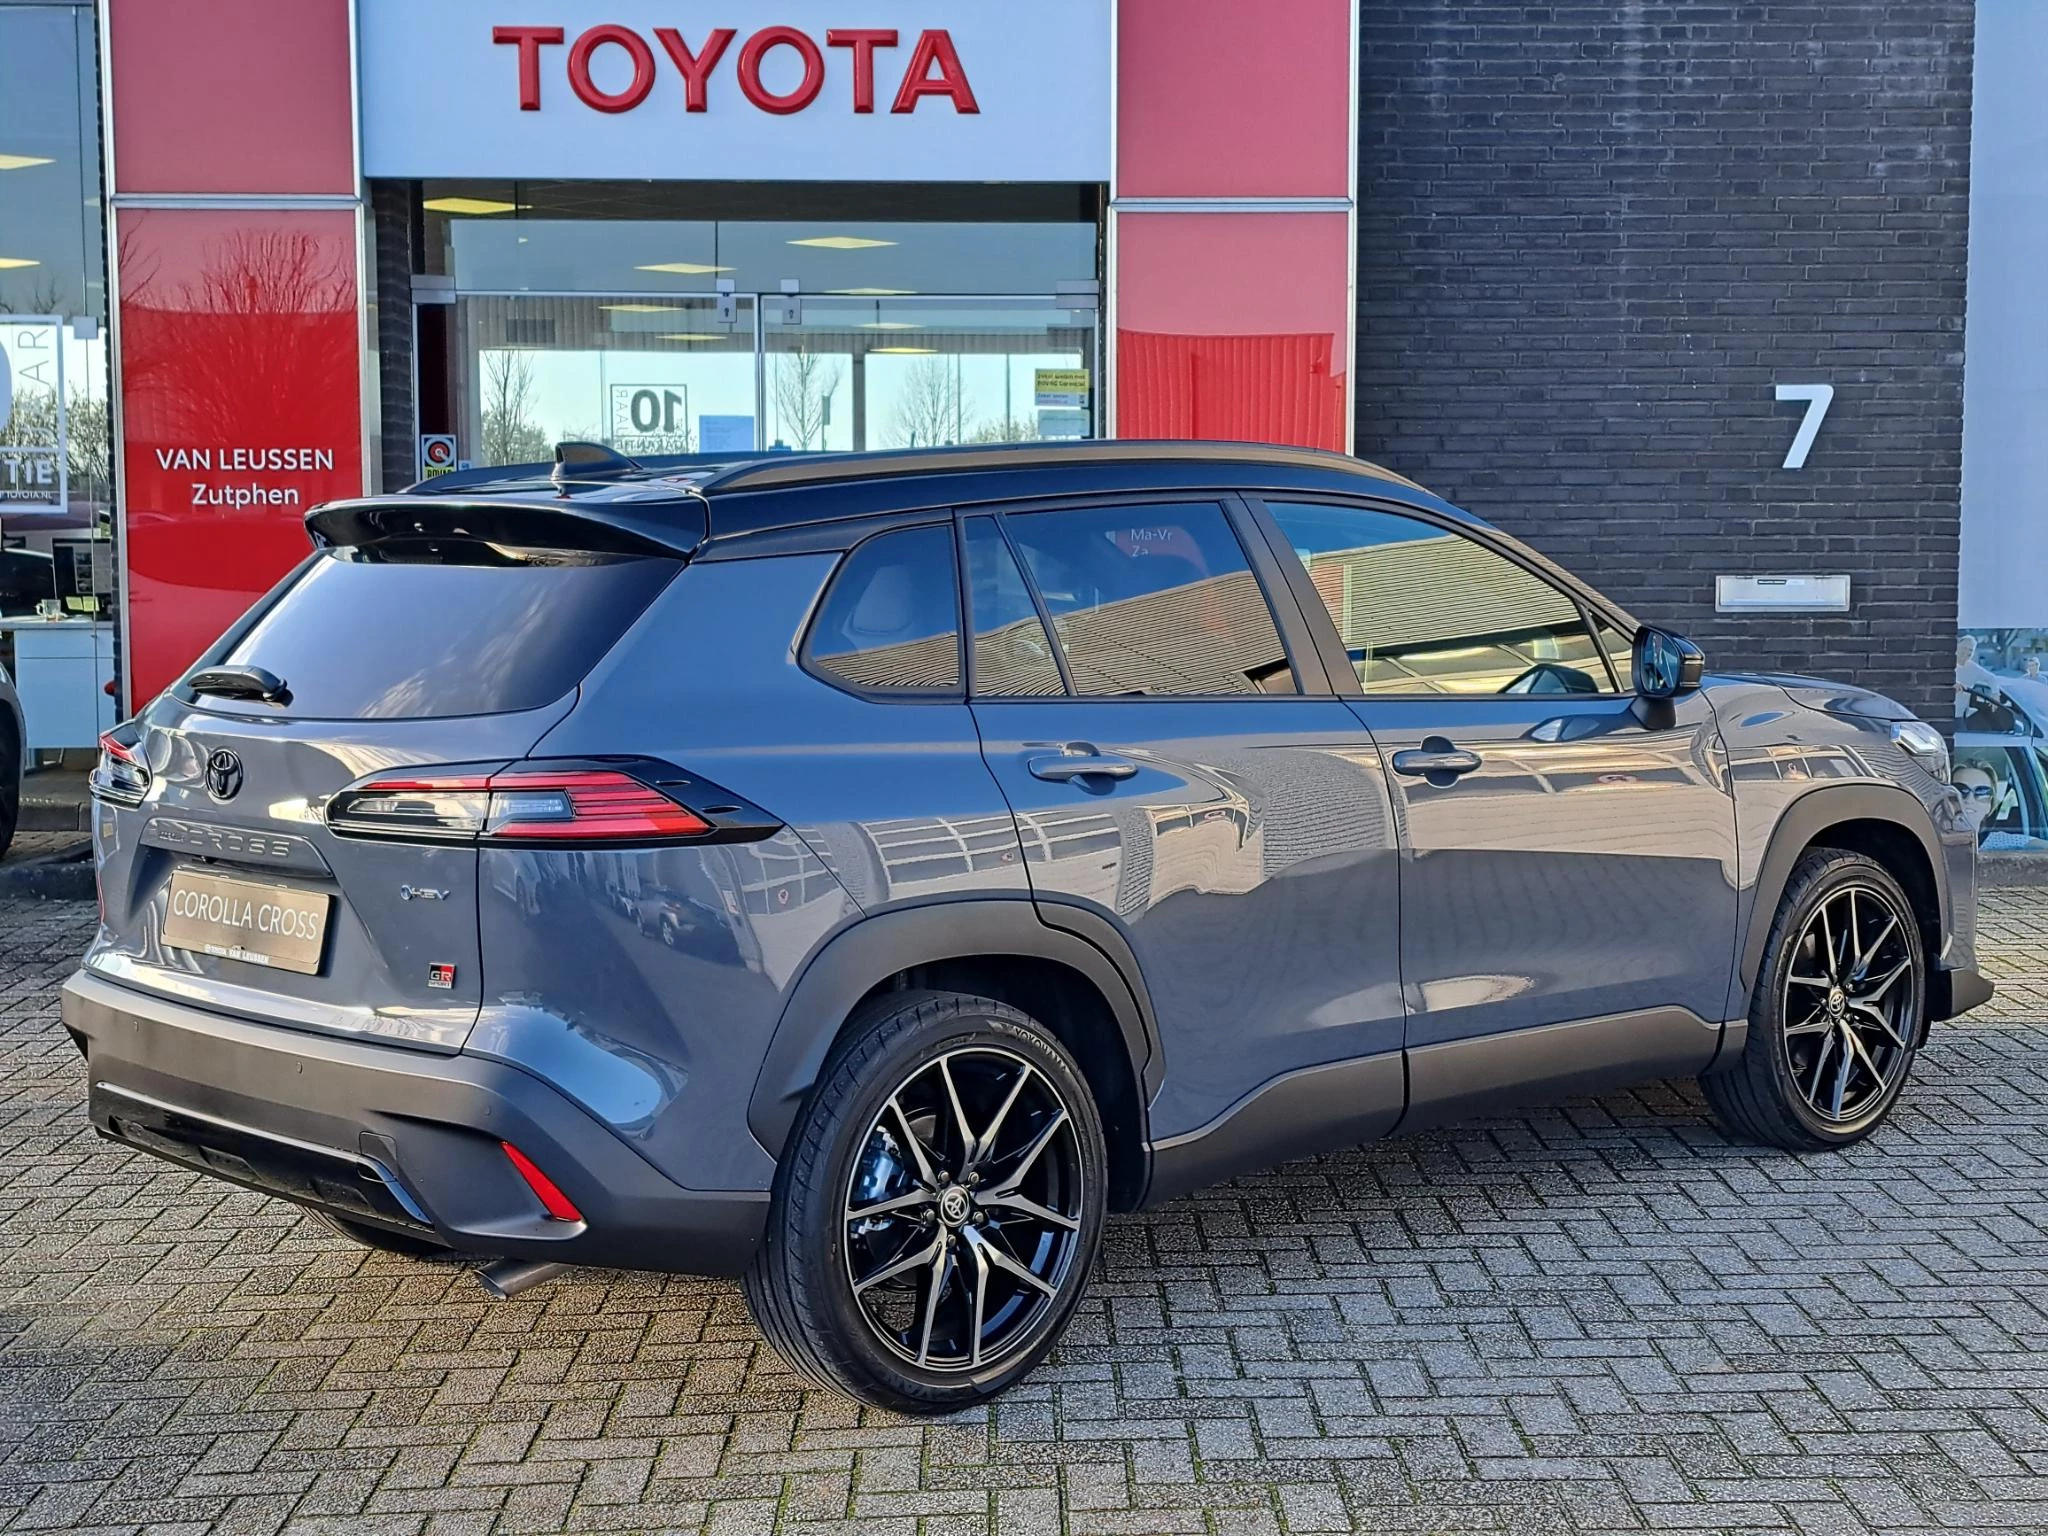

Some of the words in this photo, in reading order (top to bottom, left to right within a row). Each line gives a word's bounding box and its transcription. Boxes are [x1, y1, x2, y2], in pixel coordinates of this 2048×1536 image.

[492, 23, 981, 115] TOYOTA
[1776, 385, 1834, 468] 7
[156, 449, 210, 470] VAN
[219, 449, 332, 470] LEUSSEN
[191, 482, 298, 510] Zutphen
[173, 889, 252, 929] COROLLA
[258, 904, 320, 940] CROSS
[430, 970, 453, 982] GR
